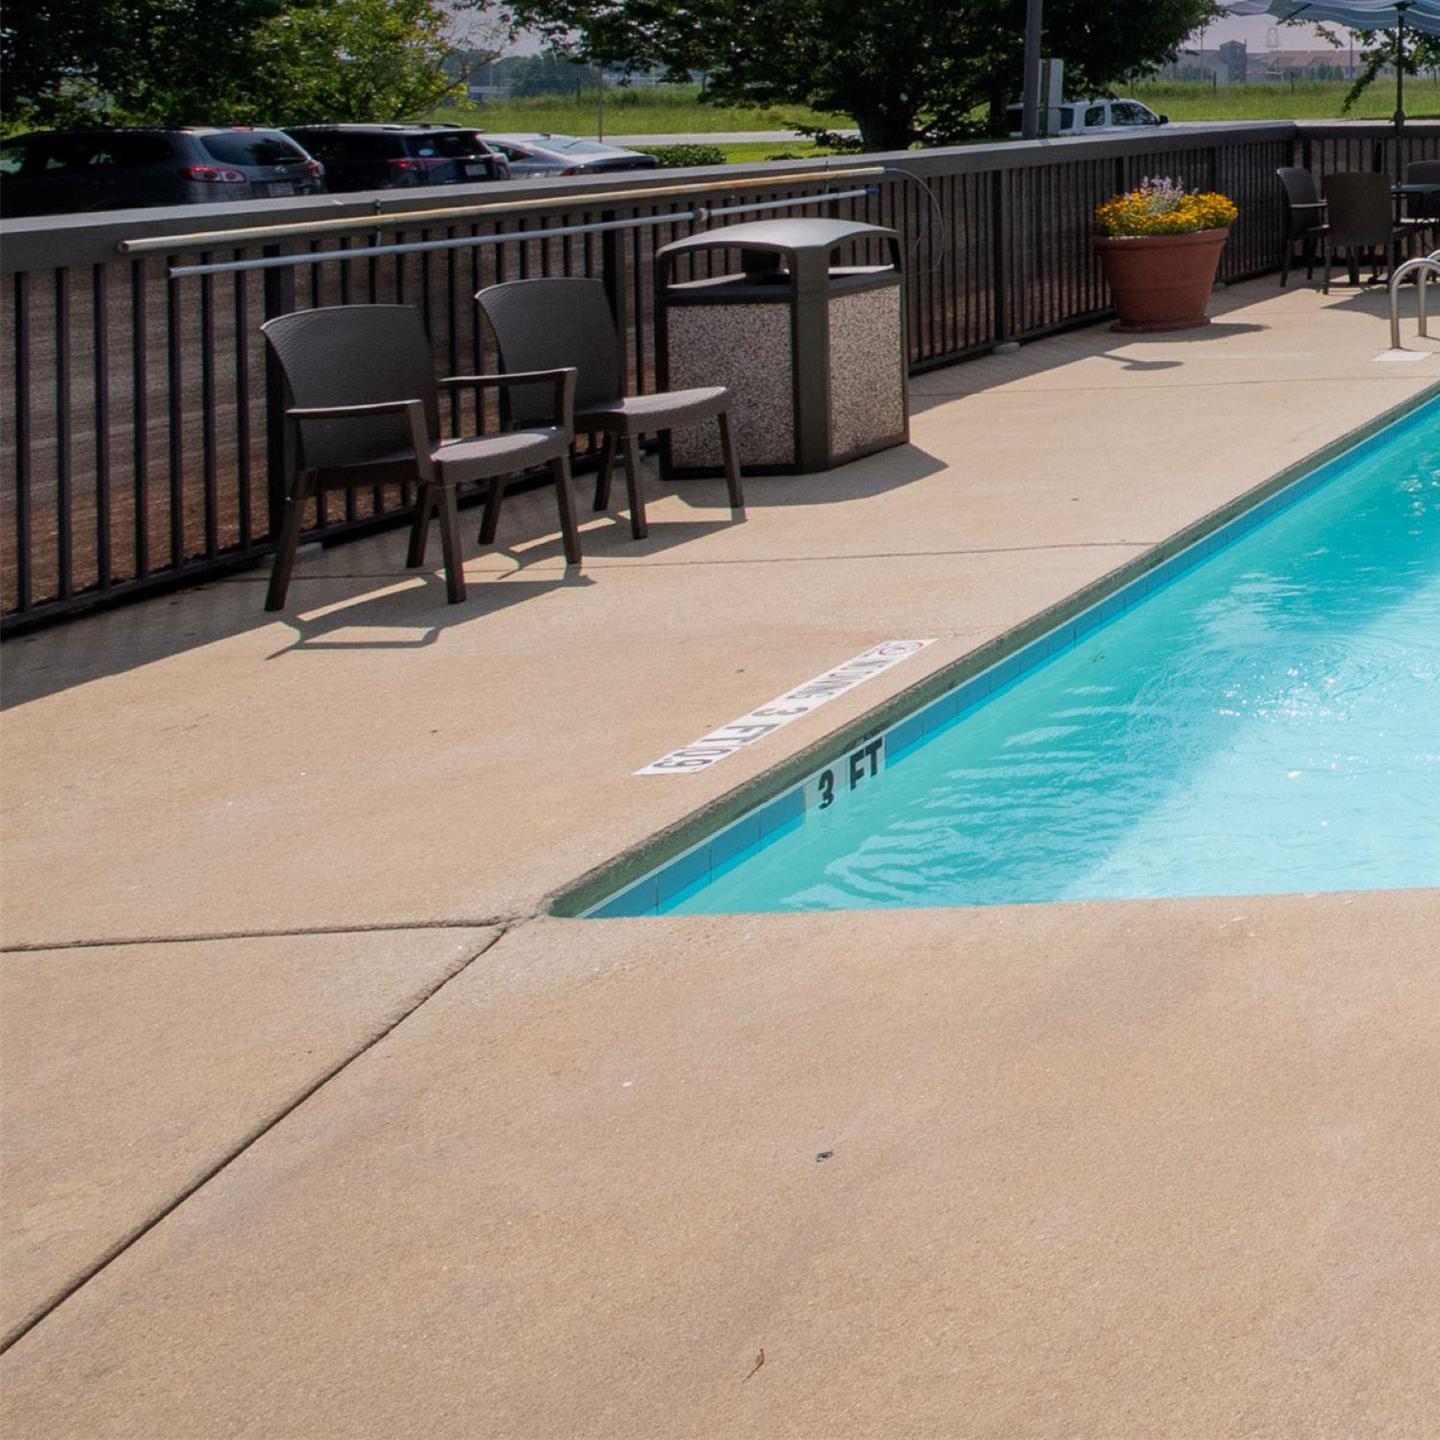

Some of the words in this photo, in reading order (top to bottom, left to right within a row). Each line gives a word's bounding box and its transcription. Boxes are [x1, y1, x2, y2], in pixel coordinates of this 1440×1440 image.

[751, 706, 809, 717] 3
[700, 723, 782, 744] FT
[818, 768, 834, 810] 3
[849, 735, 883, 793] FT
